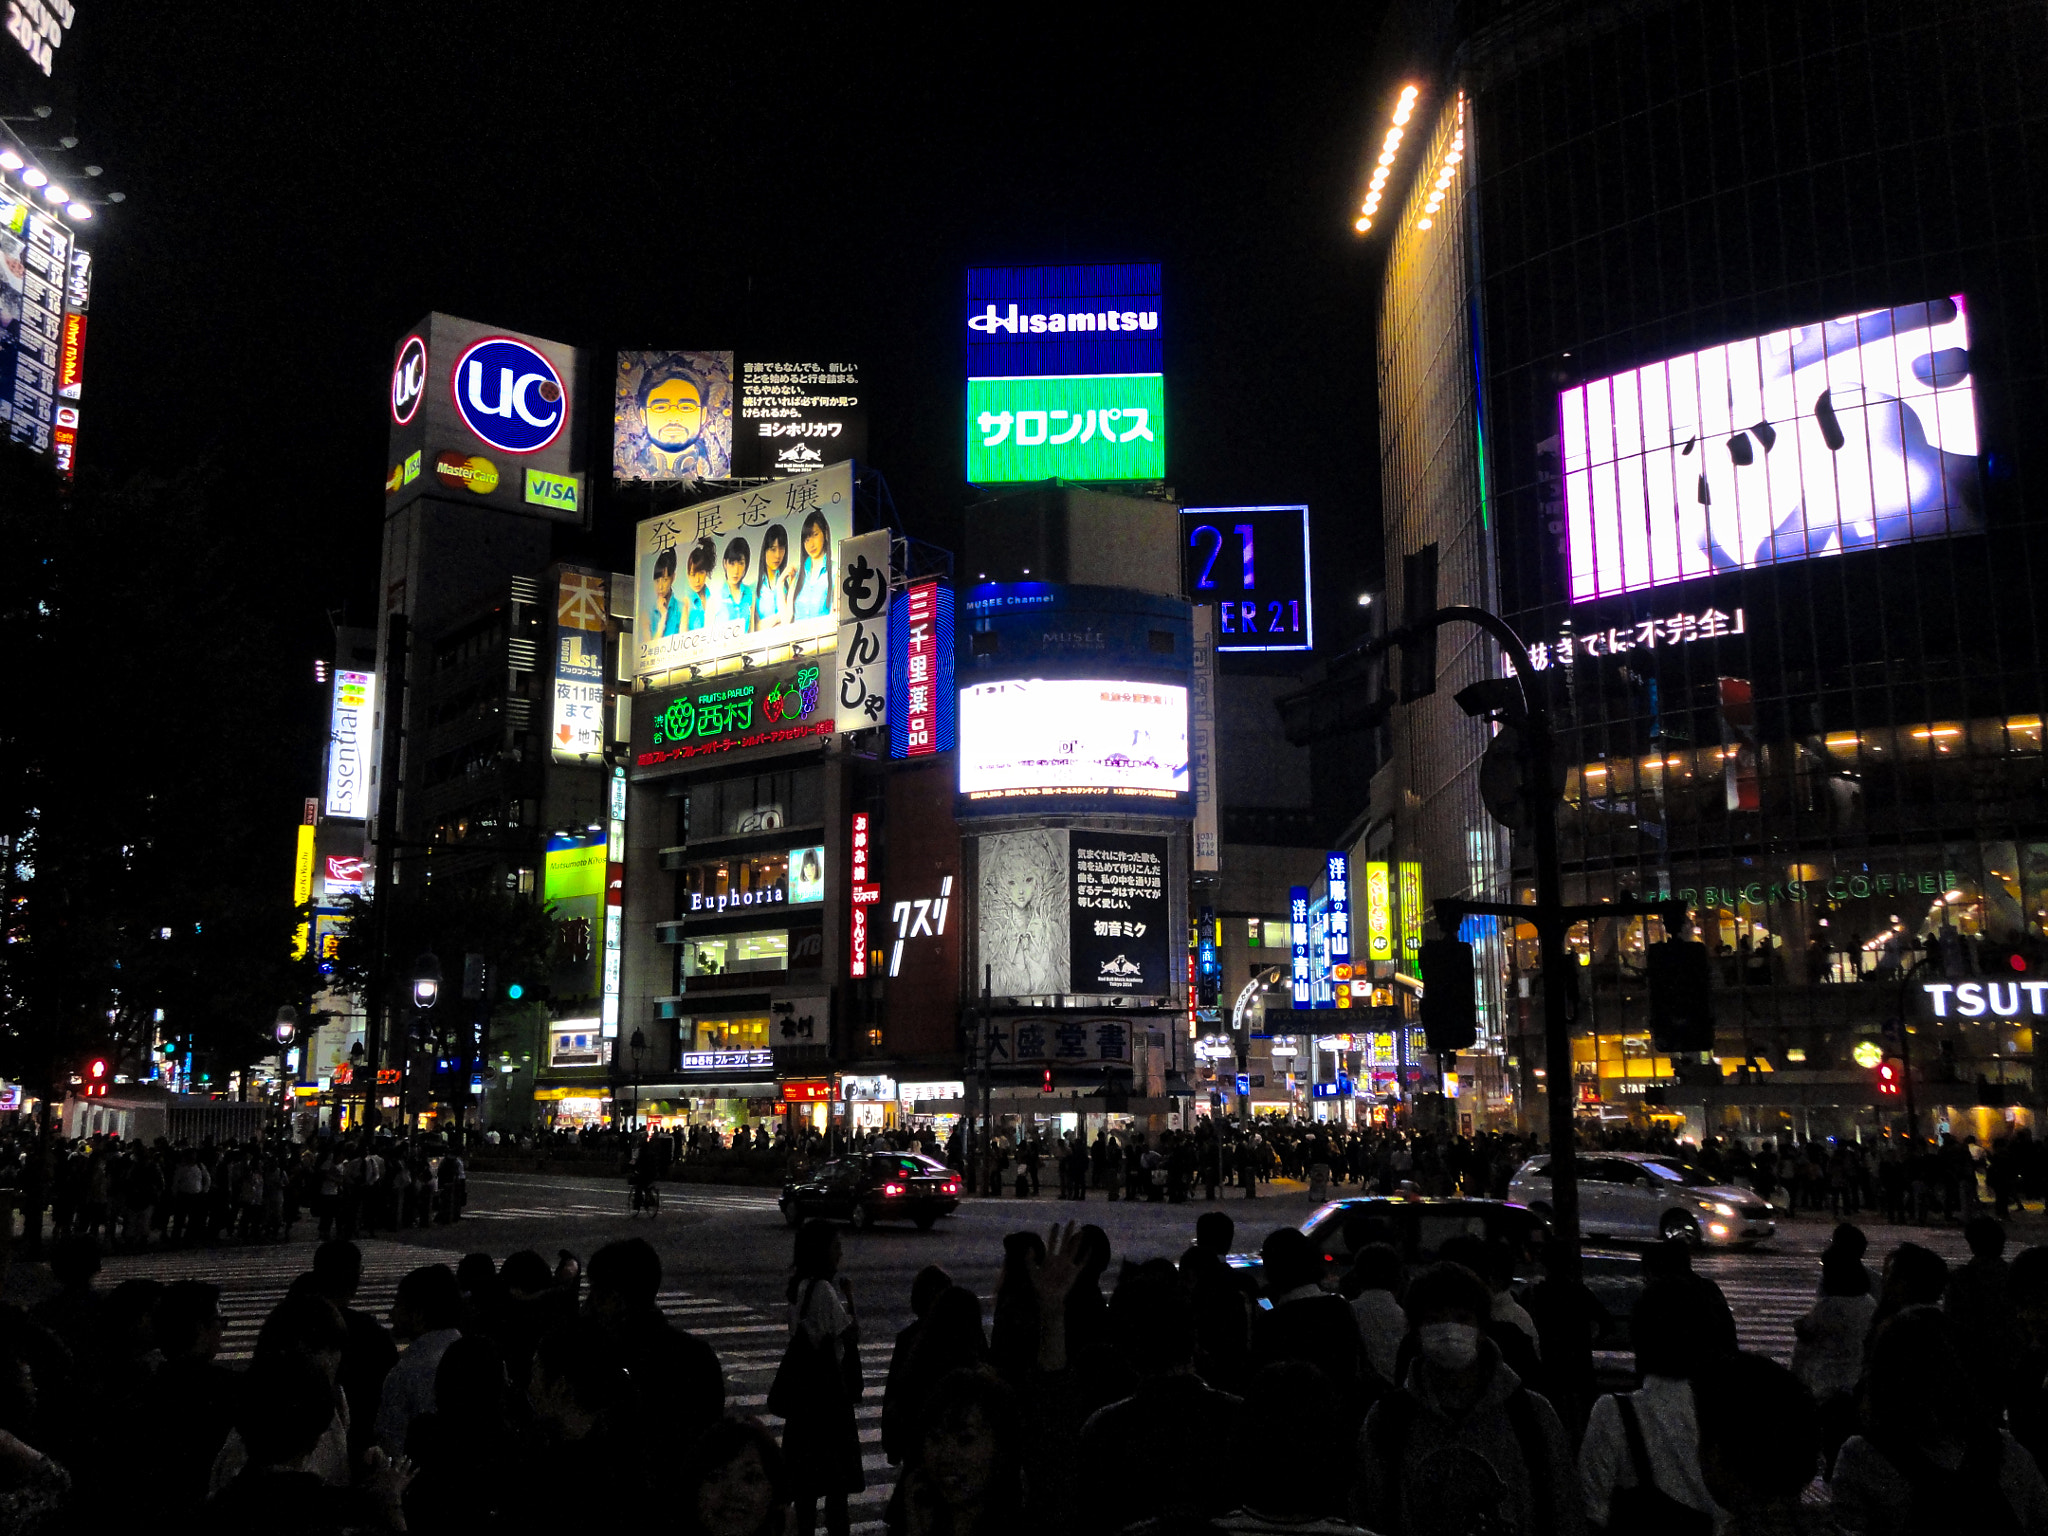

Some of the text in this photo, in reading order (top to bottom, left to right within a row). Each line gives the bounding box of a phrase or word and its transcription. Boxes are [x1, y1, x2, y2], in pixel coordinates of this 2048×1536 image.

[968, 304, 1158, 334] Hisamitsu
[744, 362, 858, 373] 音楽でもなんでも、新しい
[396, 354, 423, 406] UC
[743, 374, 858, 384] ことを始めると行き詰まる。
[468, 359, 557, 428] UC
[743, 385, 805, 395] でもやめない。
[742, 397, 858, 407] 続けていれば必ず何か見つ
[742, 408, 802, 418] けられるから。
[758, 422, 842, 438] ヨシホリカワ
[978, 408, 1153, 446] サロンパス
[437, 462, 499, 484] MasterCard
[532, 480, 576, 503] VISA
[652, 478, 842, 556] 発展途嬢。
[1190, 525, 1255, 589] 21
[558, 575, 606, 630] 本
[1006, 594, 1054, 605] Channel
[841, 555, 887, 722] もんじゃ
[909, 592, 929, 746] 三千里薬品
[557, 683, 603, 704] 夜11時
[566, 704, 593, 719] まで
[699, 699, 753, 736] 西村
[654, 716, 664, 744] 渋谷
[330, 706, 358, 816] Essential
[1077, 849, 1161, 863] 気まぐれに作った歌も、
[1077, 861, 1161, 875] 魂を込めて作りこんだ
[1077, 874, 1161, 887] 曲も、私の中を通り過
[691, 885, 783, 912] Euphoria
[1077, 886, 1161, 899] ぎるデータはすべてが
[1077, 897, 1131, 910] 等しく愛しい。
[1094, 921, 1147, 938] 初音ミク
